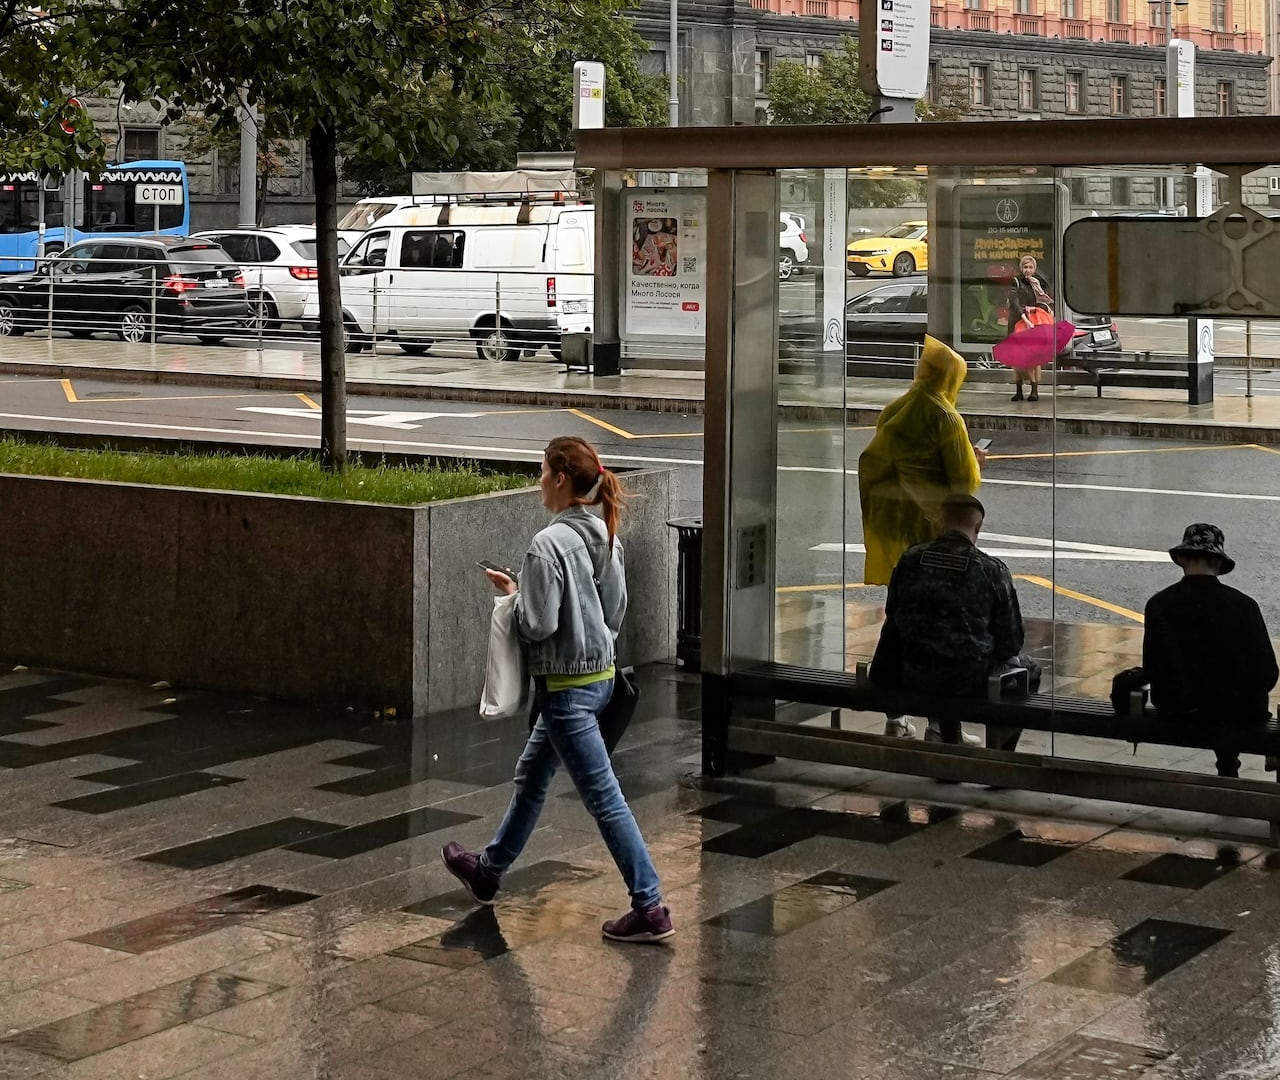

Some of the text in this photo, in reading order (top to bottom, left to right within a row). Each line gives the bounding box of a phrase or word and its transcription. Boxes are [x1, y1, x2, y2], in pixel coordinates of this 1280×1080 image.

[143, 188, 176, 201] СТОП
[975, 238, 1044, 250] ДИНОЗАВРЫ
[975, 250, 987, 260] НА
[631, 280, 679, 290] Качественно,
